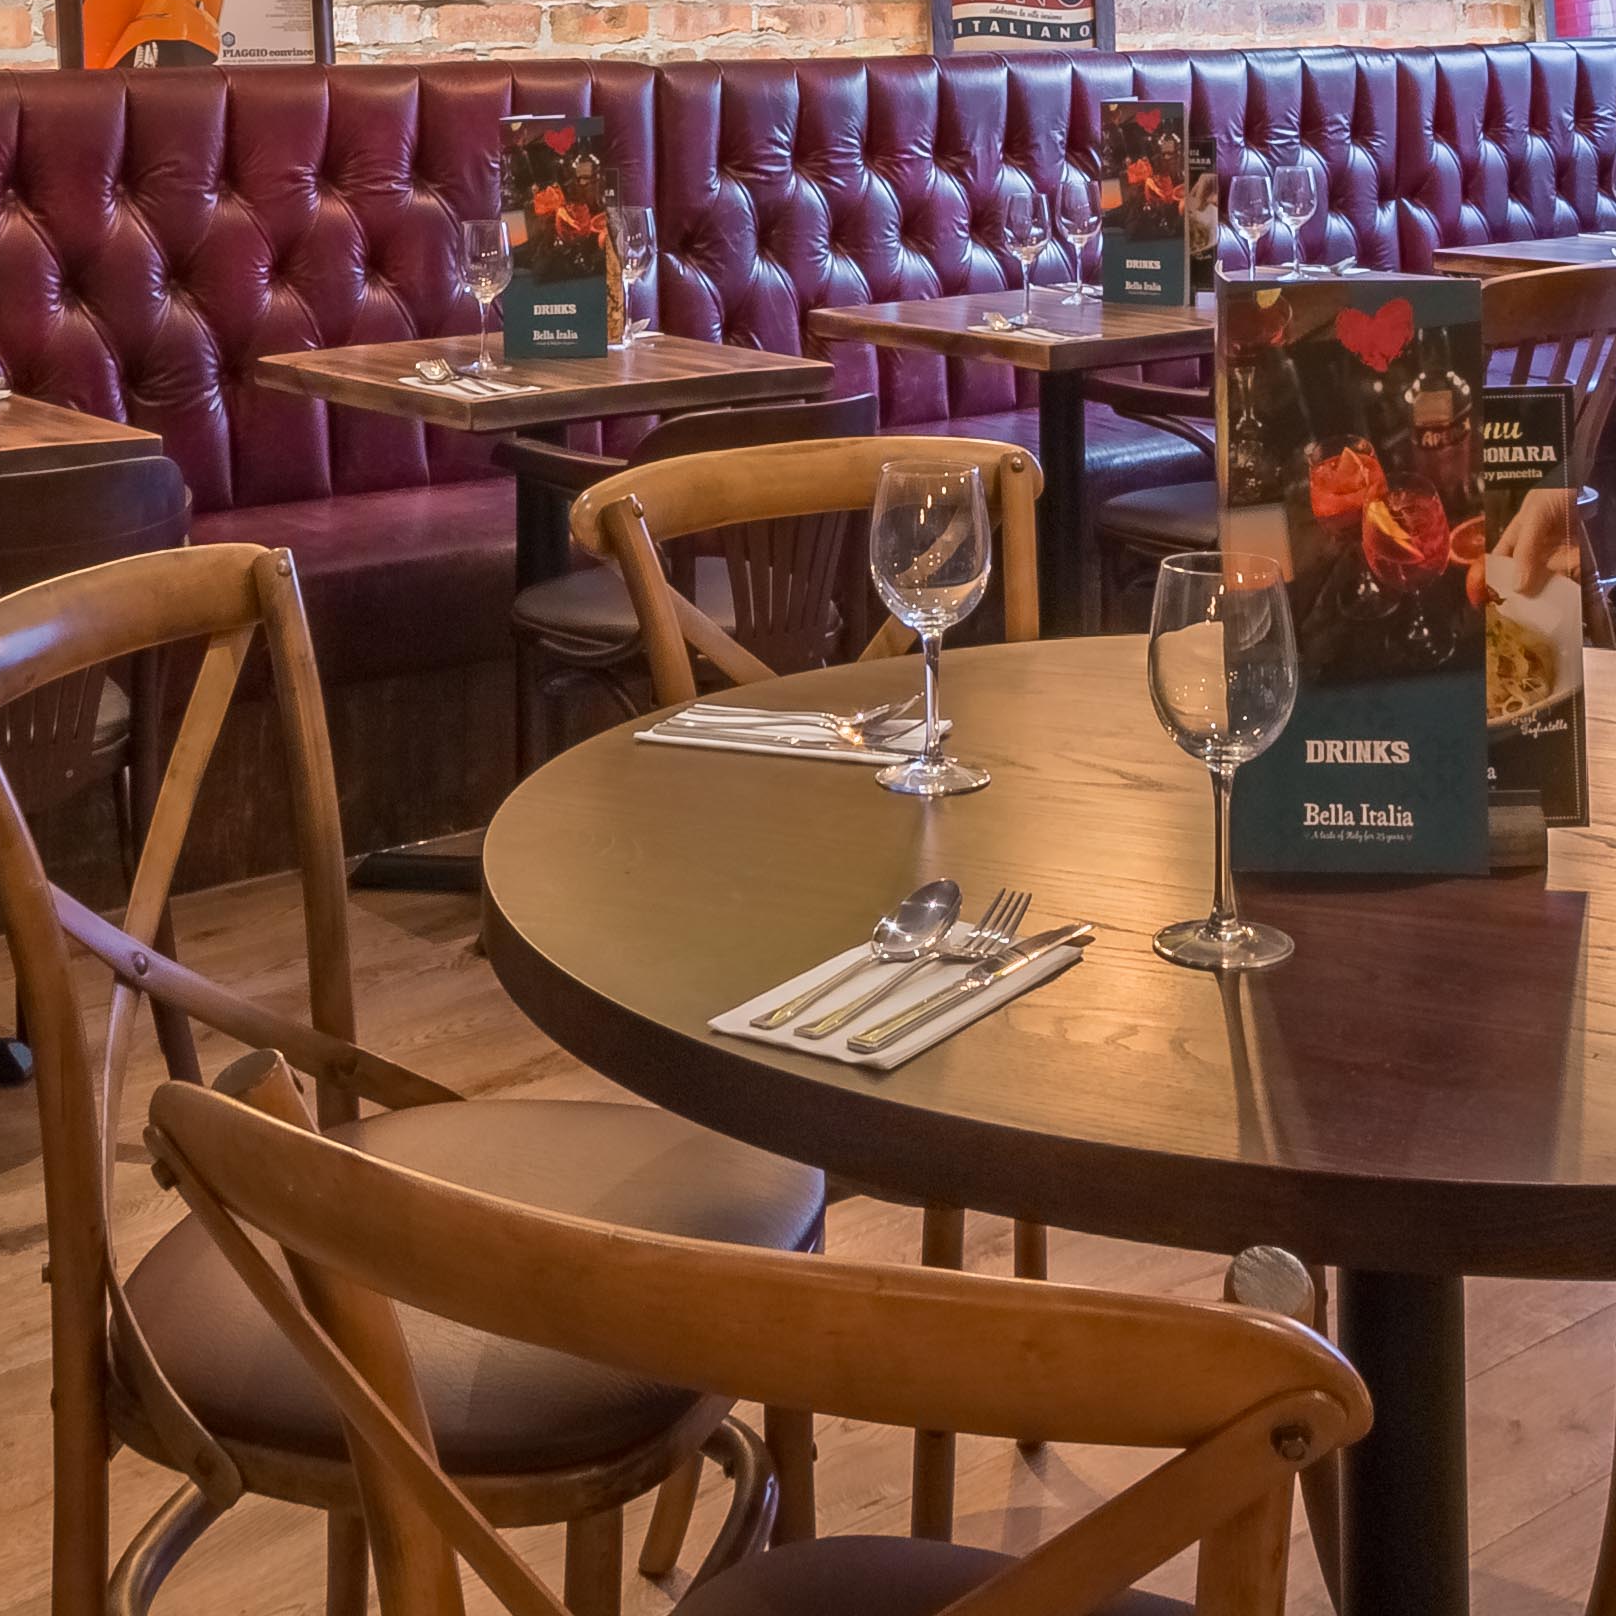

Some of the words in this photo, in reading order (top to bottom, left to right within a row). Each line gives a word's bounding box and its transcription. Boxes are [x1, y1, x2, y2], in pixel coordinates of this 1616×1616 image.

[957, 20, 1091, 39] ITALIANO
[222, 48, 268, 58] PIAGGIO
[269, 47, 314, 57] convince
[1483, 445, 1557, 463] ONARA
[1496, 468, 1543, 481] pancetta
[1305, 739, 1411, 764] DRINKS
[1303, 802, 1356, 826] Bella
[1359, 803, 1414, 827] Italia
